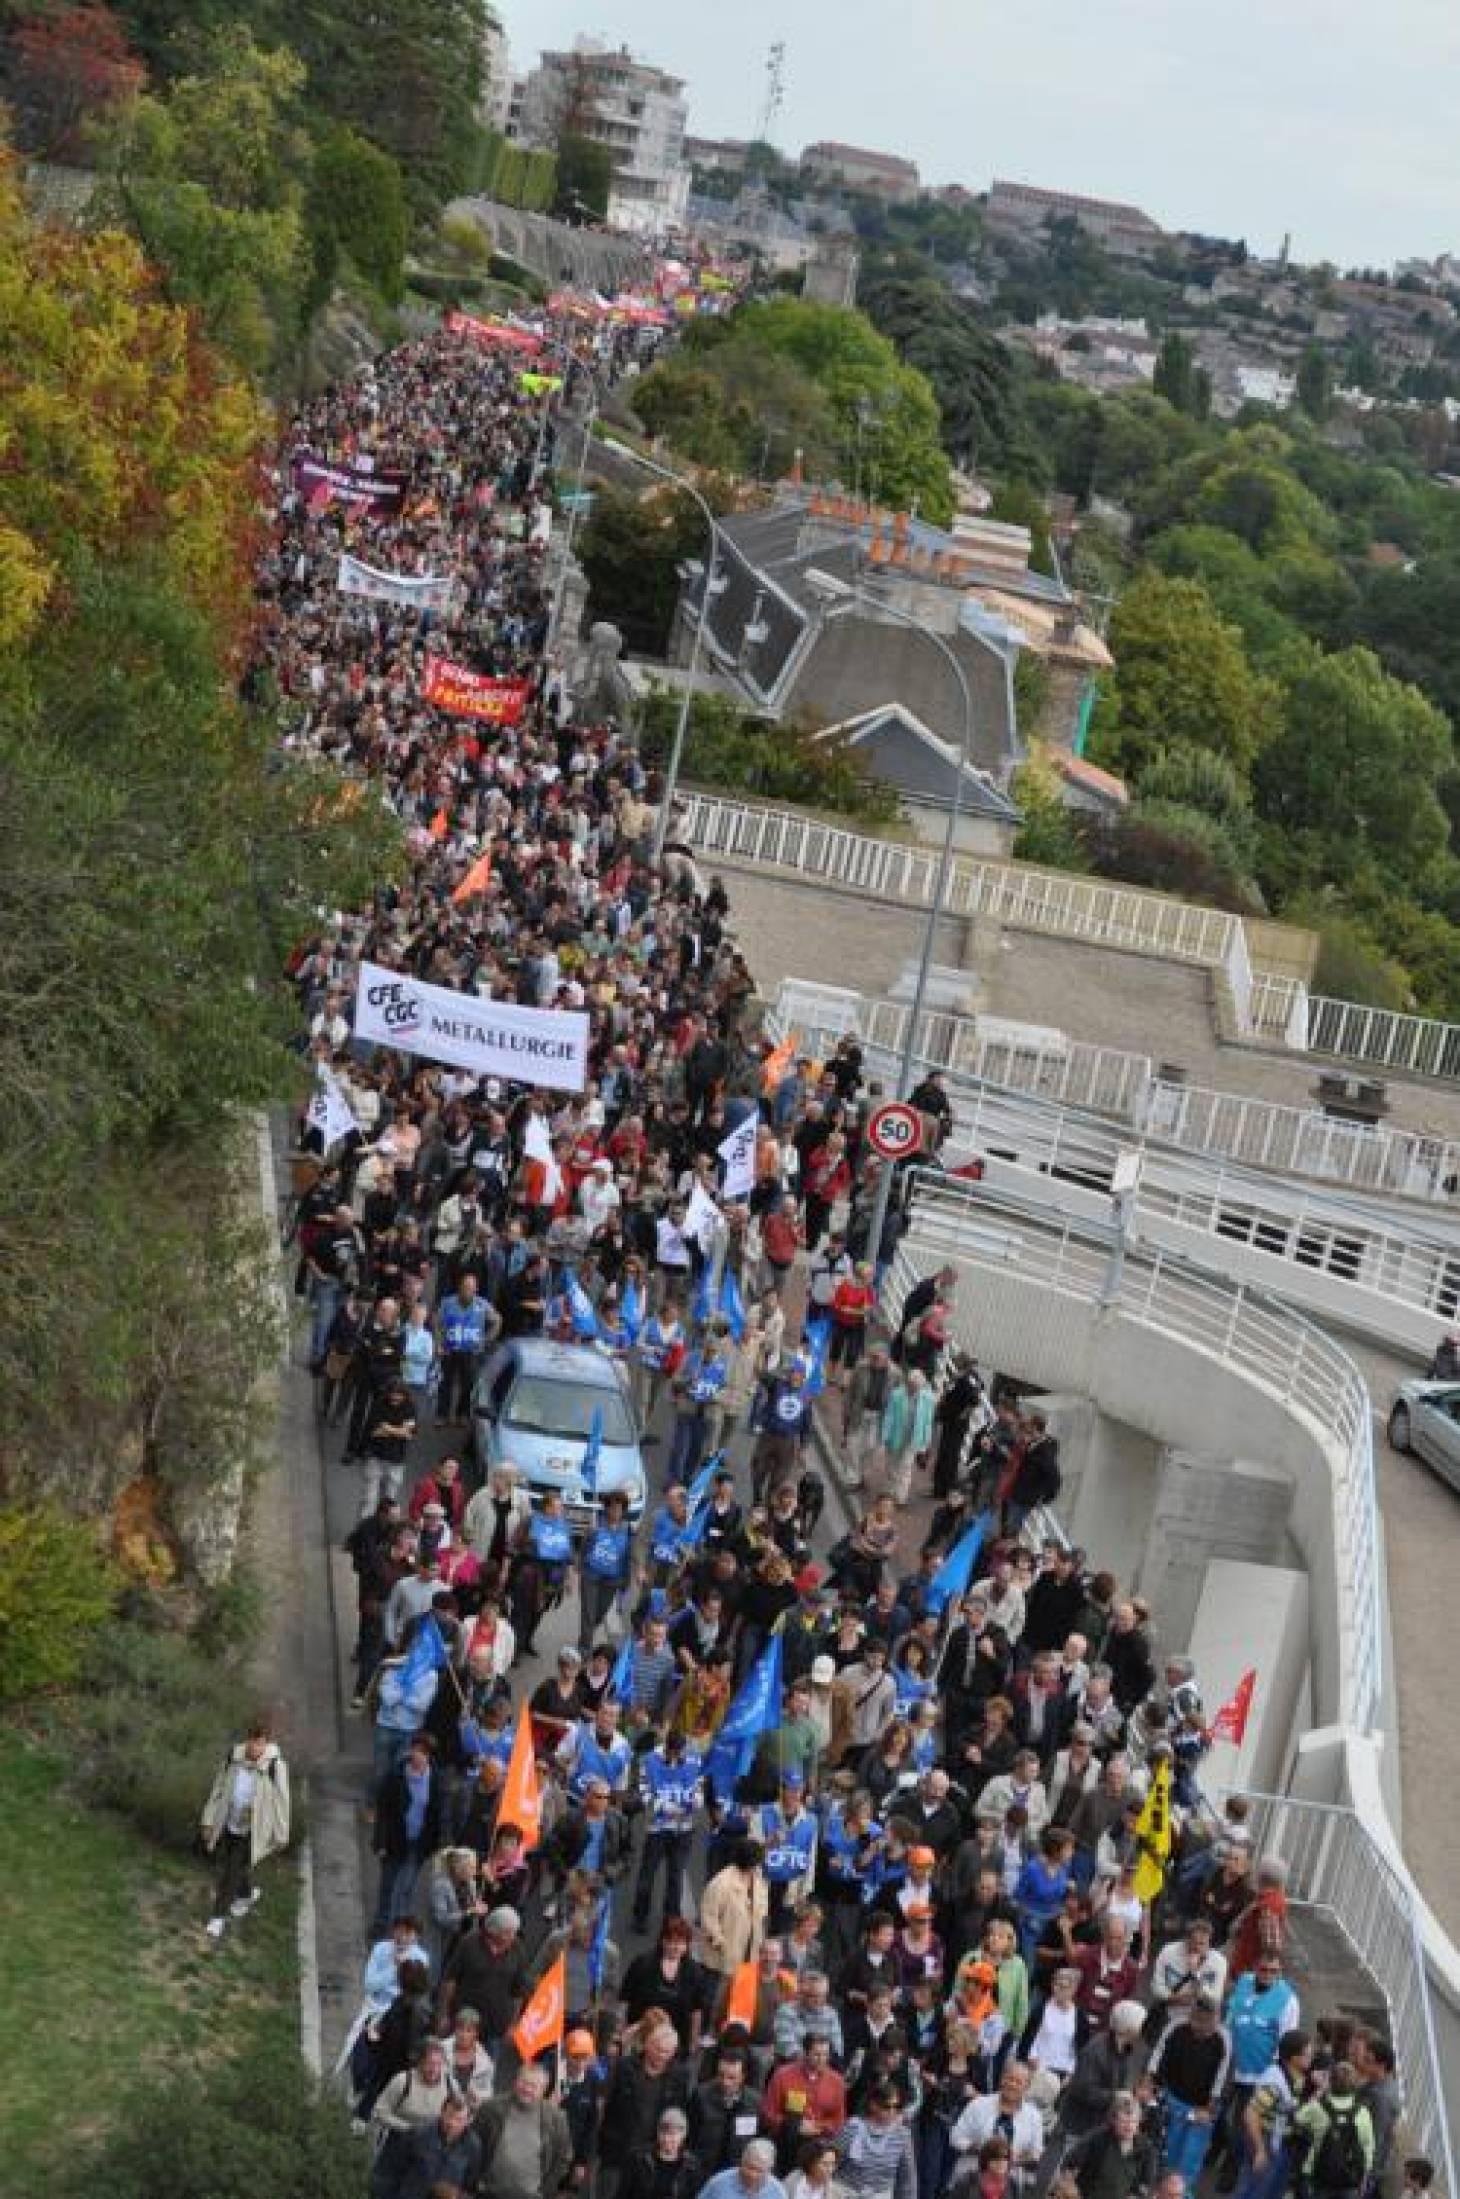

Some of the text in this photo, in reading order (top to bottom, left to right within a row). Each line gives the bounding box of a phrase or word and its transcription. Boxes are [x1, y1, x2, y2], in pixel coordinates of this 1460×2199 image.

[367, 983, 403, 1006] CFE
[385, 1001, 418, 1025] CGC
[432, 1016, 576, 1061] METALLURGIE
[881, 1118, 909, 1142] 50
[766, 1847, 808, 1871] CFTC
